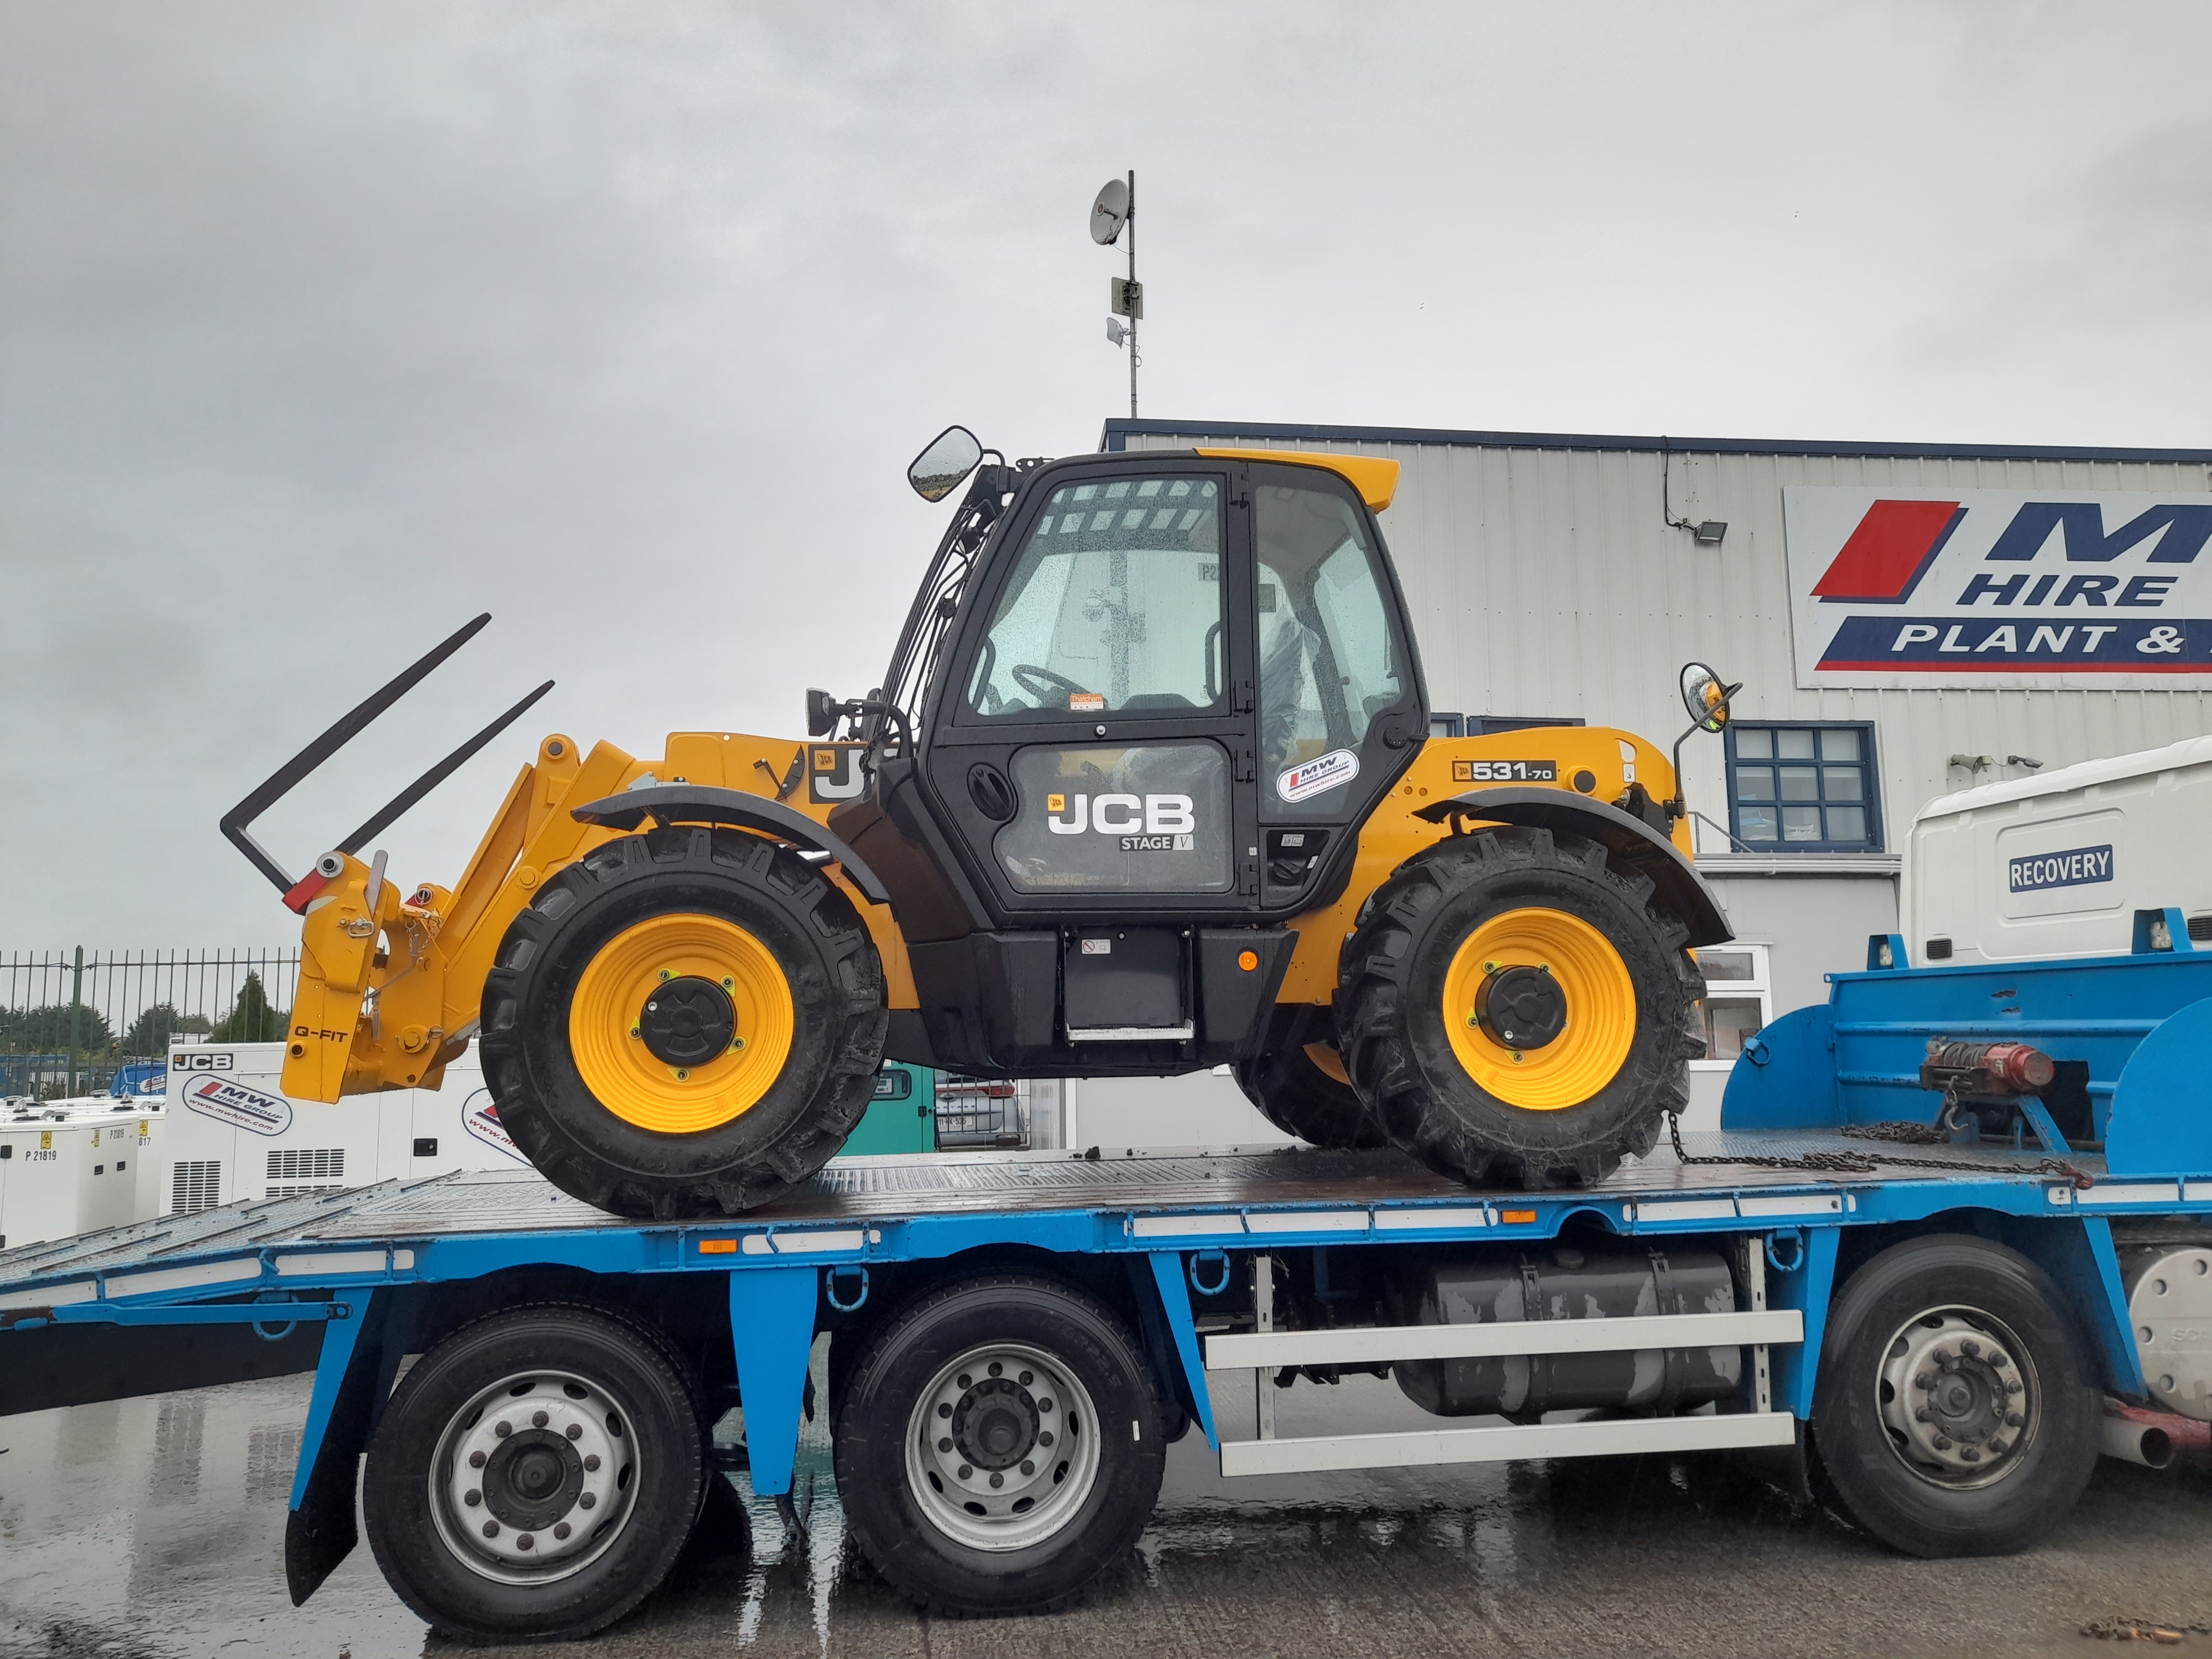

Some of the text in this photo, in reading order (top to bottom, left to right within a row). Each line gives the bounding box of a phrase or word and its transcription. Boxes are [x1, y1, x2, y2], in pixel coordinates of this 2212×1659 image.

[1202, 564, 1219, 581] P2
[1955, 573, 2179, 607] HIRE
[1890, 624, 2185, 654] PLANT &
[1300, 760, 1349, 783] HIRE GROUP
[1301, 756, 1337, 778] MW
[1289, 770, 1350, 798] www.mwhire.com
[1048, 794, 1195, 834] JCB
[1121, 836, 1190, 850] STAGE V
[2011, 851, 2110, 888] RECOVERY
[294, 1026, 348, 1042] Q-FIT
[174, 1054, 232, 1071] JCB
[213, 1093, 284, 1120] HIRE GROUP
[220, 1086, 276, 1108] MW
[188, 1098, 274, 1131] www.mwhire.com
[25, 1150, 57, 1161] P 21819
